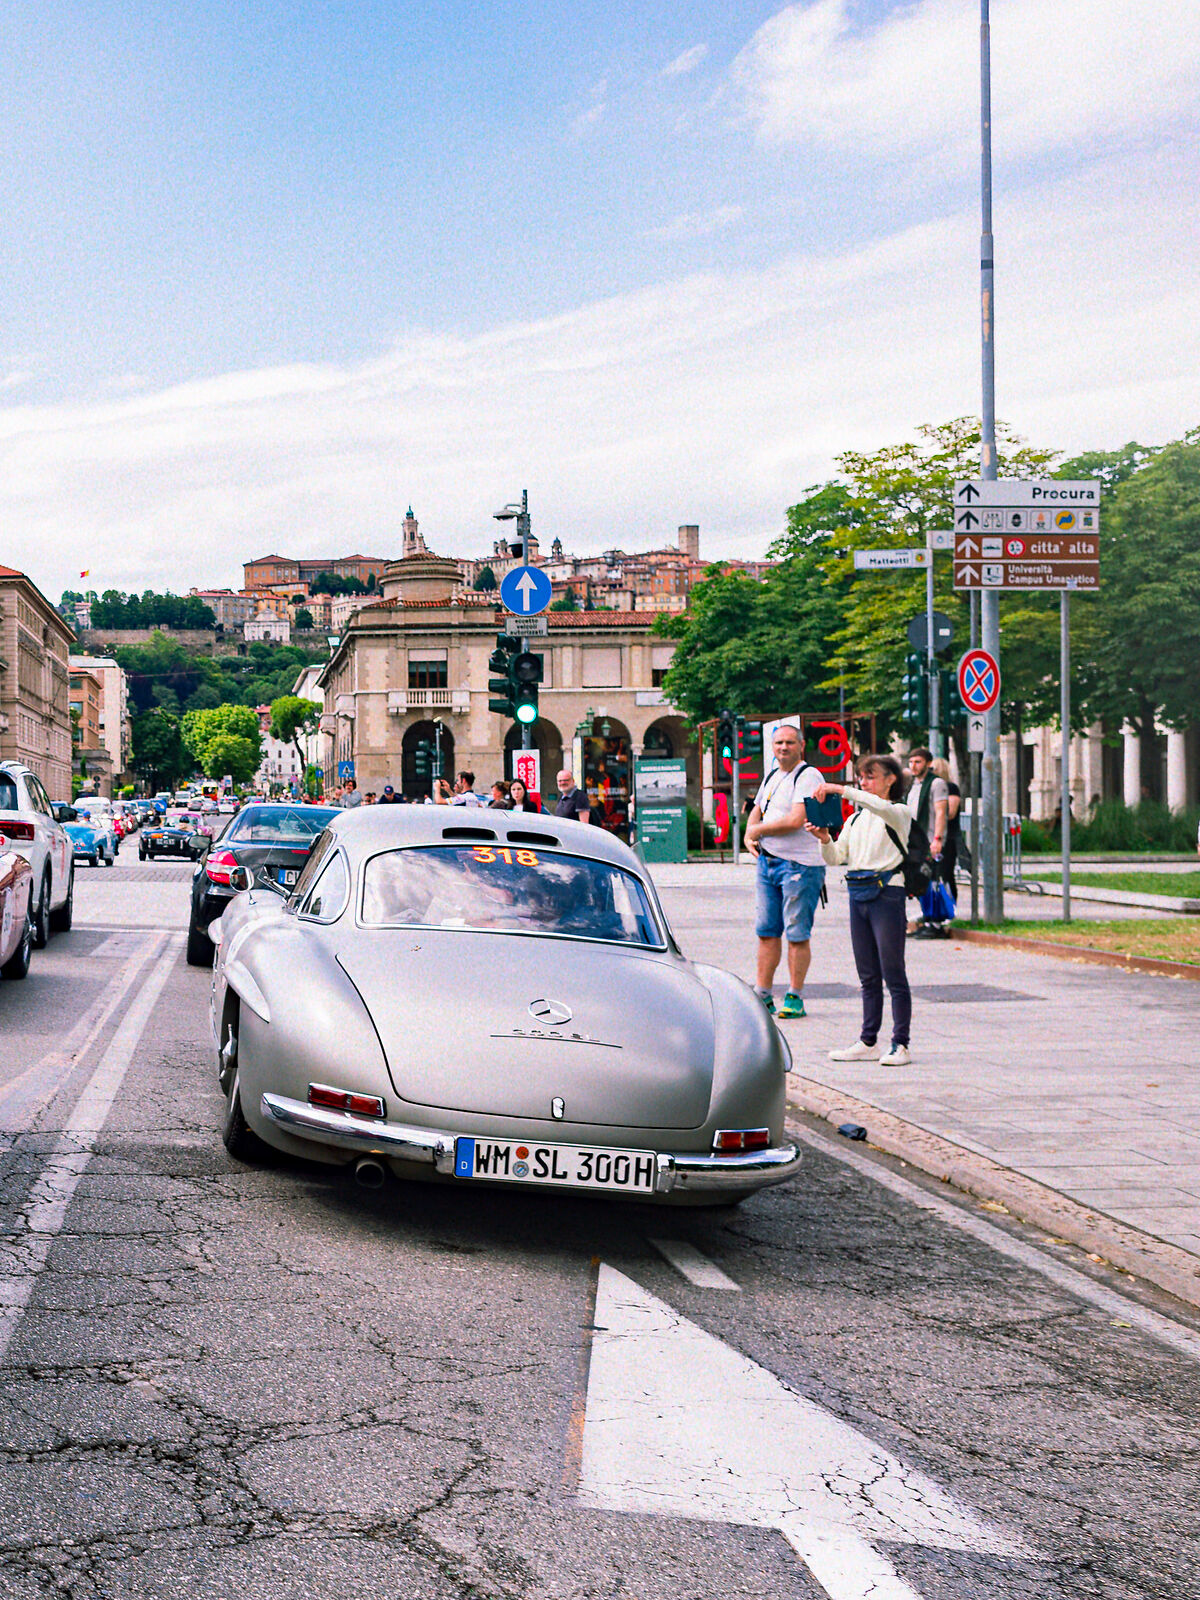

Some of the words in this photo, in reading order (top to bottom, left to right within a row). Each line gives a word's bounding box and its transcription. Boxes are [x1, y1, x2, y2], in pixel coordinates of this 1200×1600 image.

[1032, 487, 1095, 499] Procura
[1069, 541, 1095, 554] alta
[1008, 574, 1043, 584] Campus
[472, 846, 538, 866] 318
[461, 1161, 468, 1170] D
[475, 1144, 510, 1175] WM
[533, 1148, 568, 1179] SL
[576, 1152, 652, 1187] 300H
